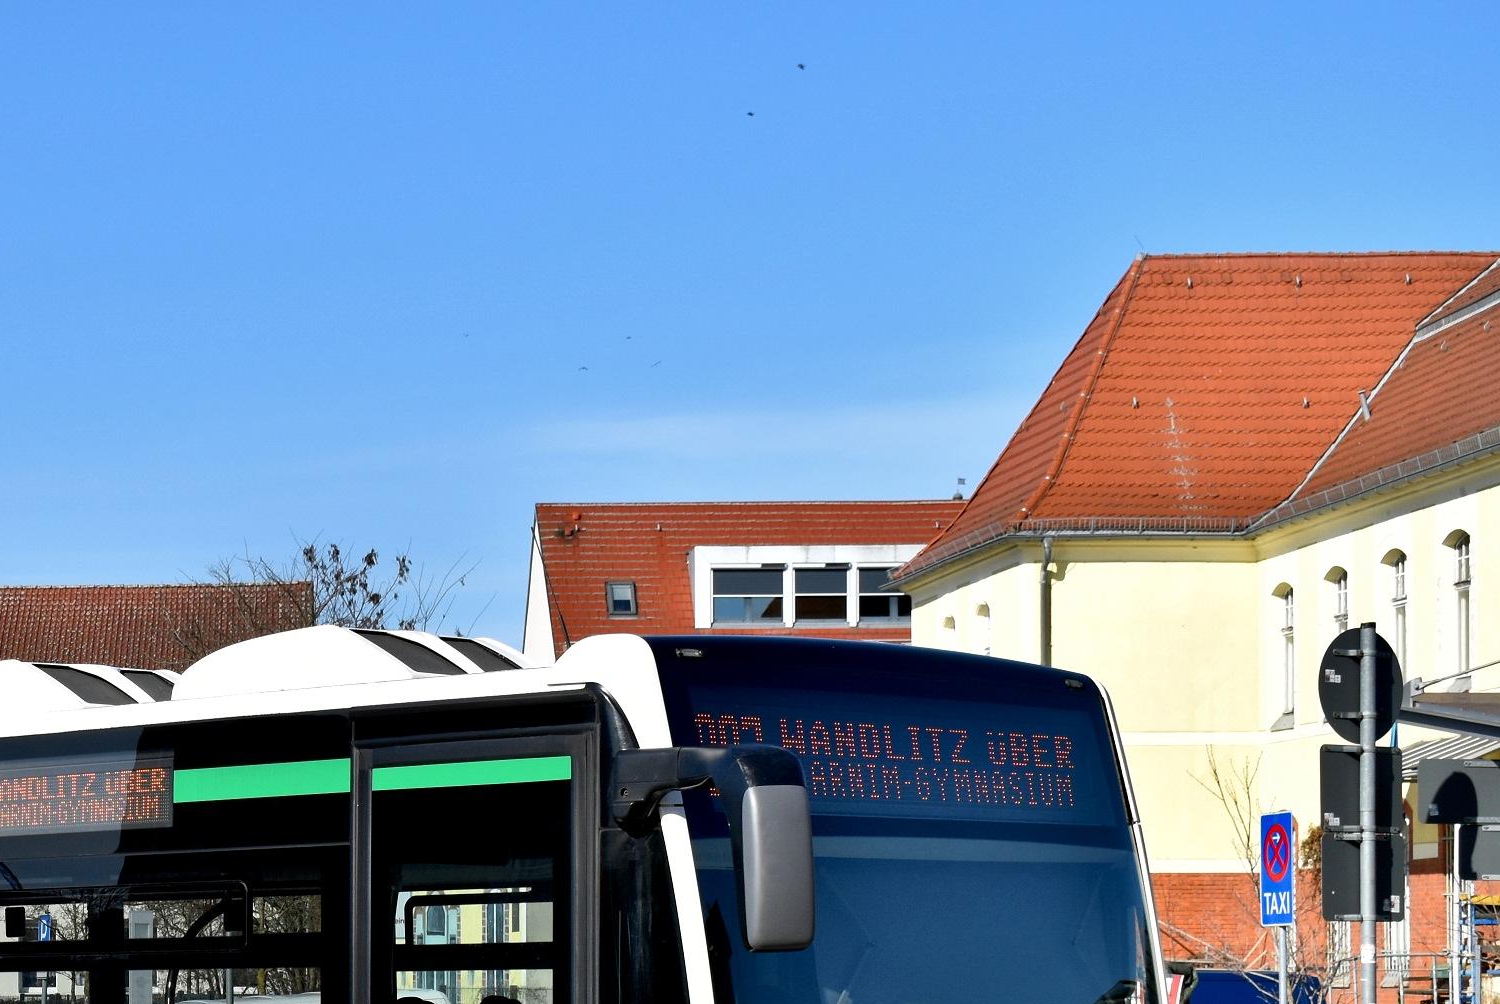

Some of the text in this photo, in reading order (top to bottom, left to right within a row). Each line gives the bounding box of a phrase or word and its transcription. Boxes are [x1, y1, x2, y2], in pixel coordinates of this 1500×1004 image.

[780, 717, 971, 763] WANDLITZ
[986, 731, 1074, 768] ÜBER
[104, 768, 166, 795] ÜBER
[811, 760, 1074, 806] ARNIM-GYMNASIUM
[1263, 891, 1290, 915] TAXI
